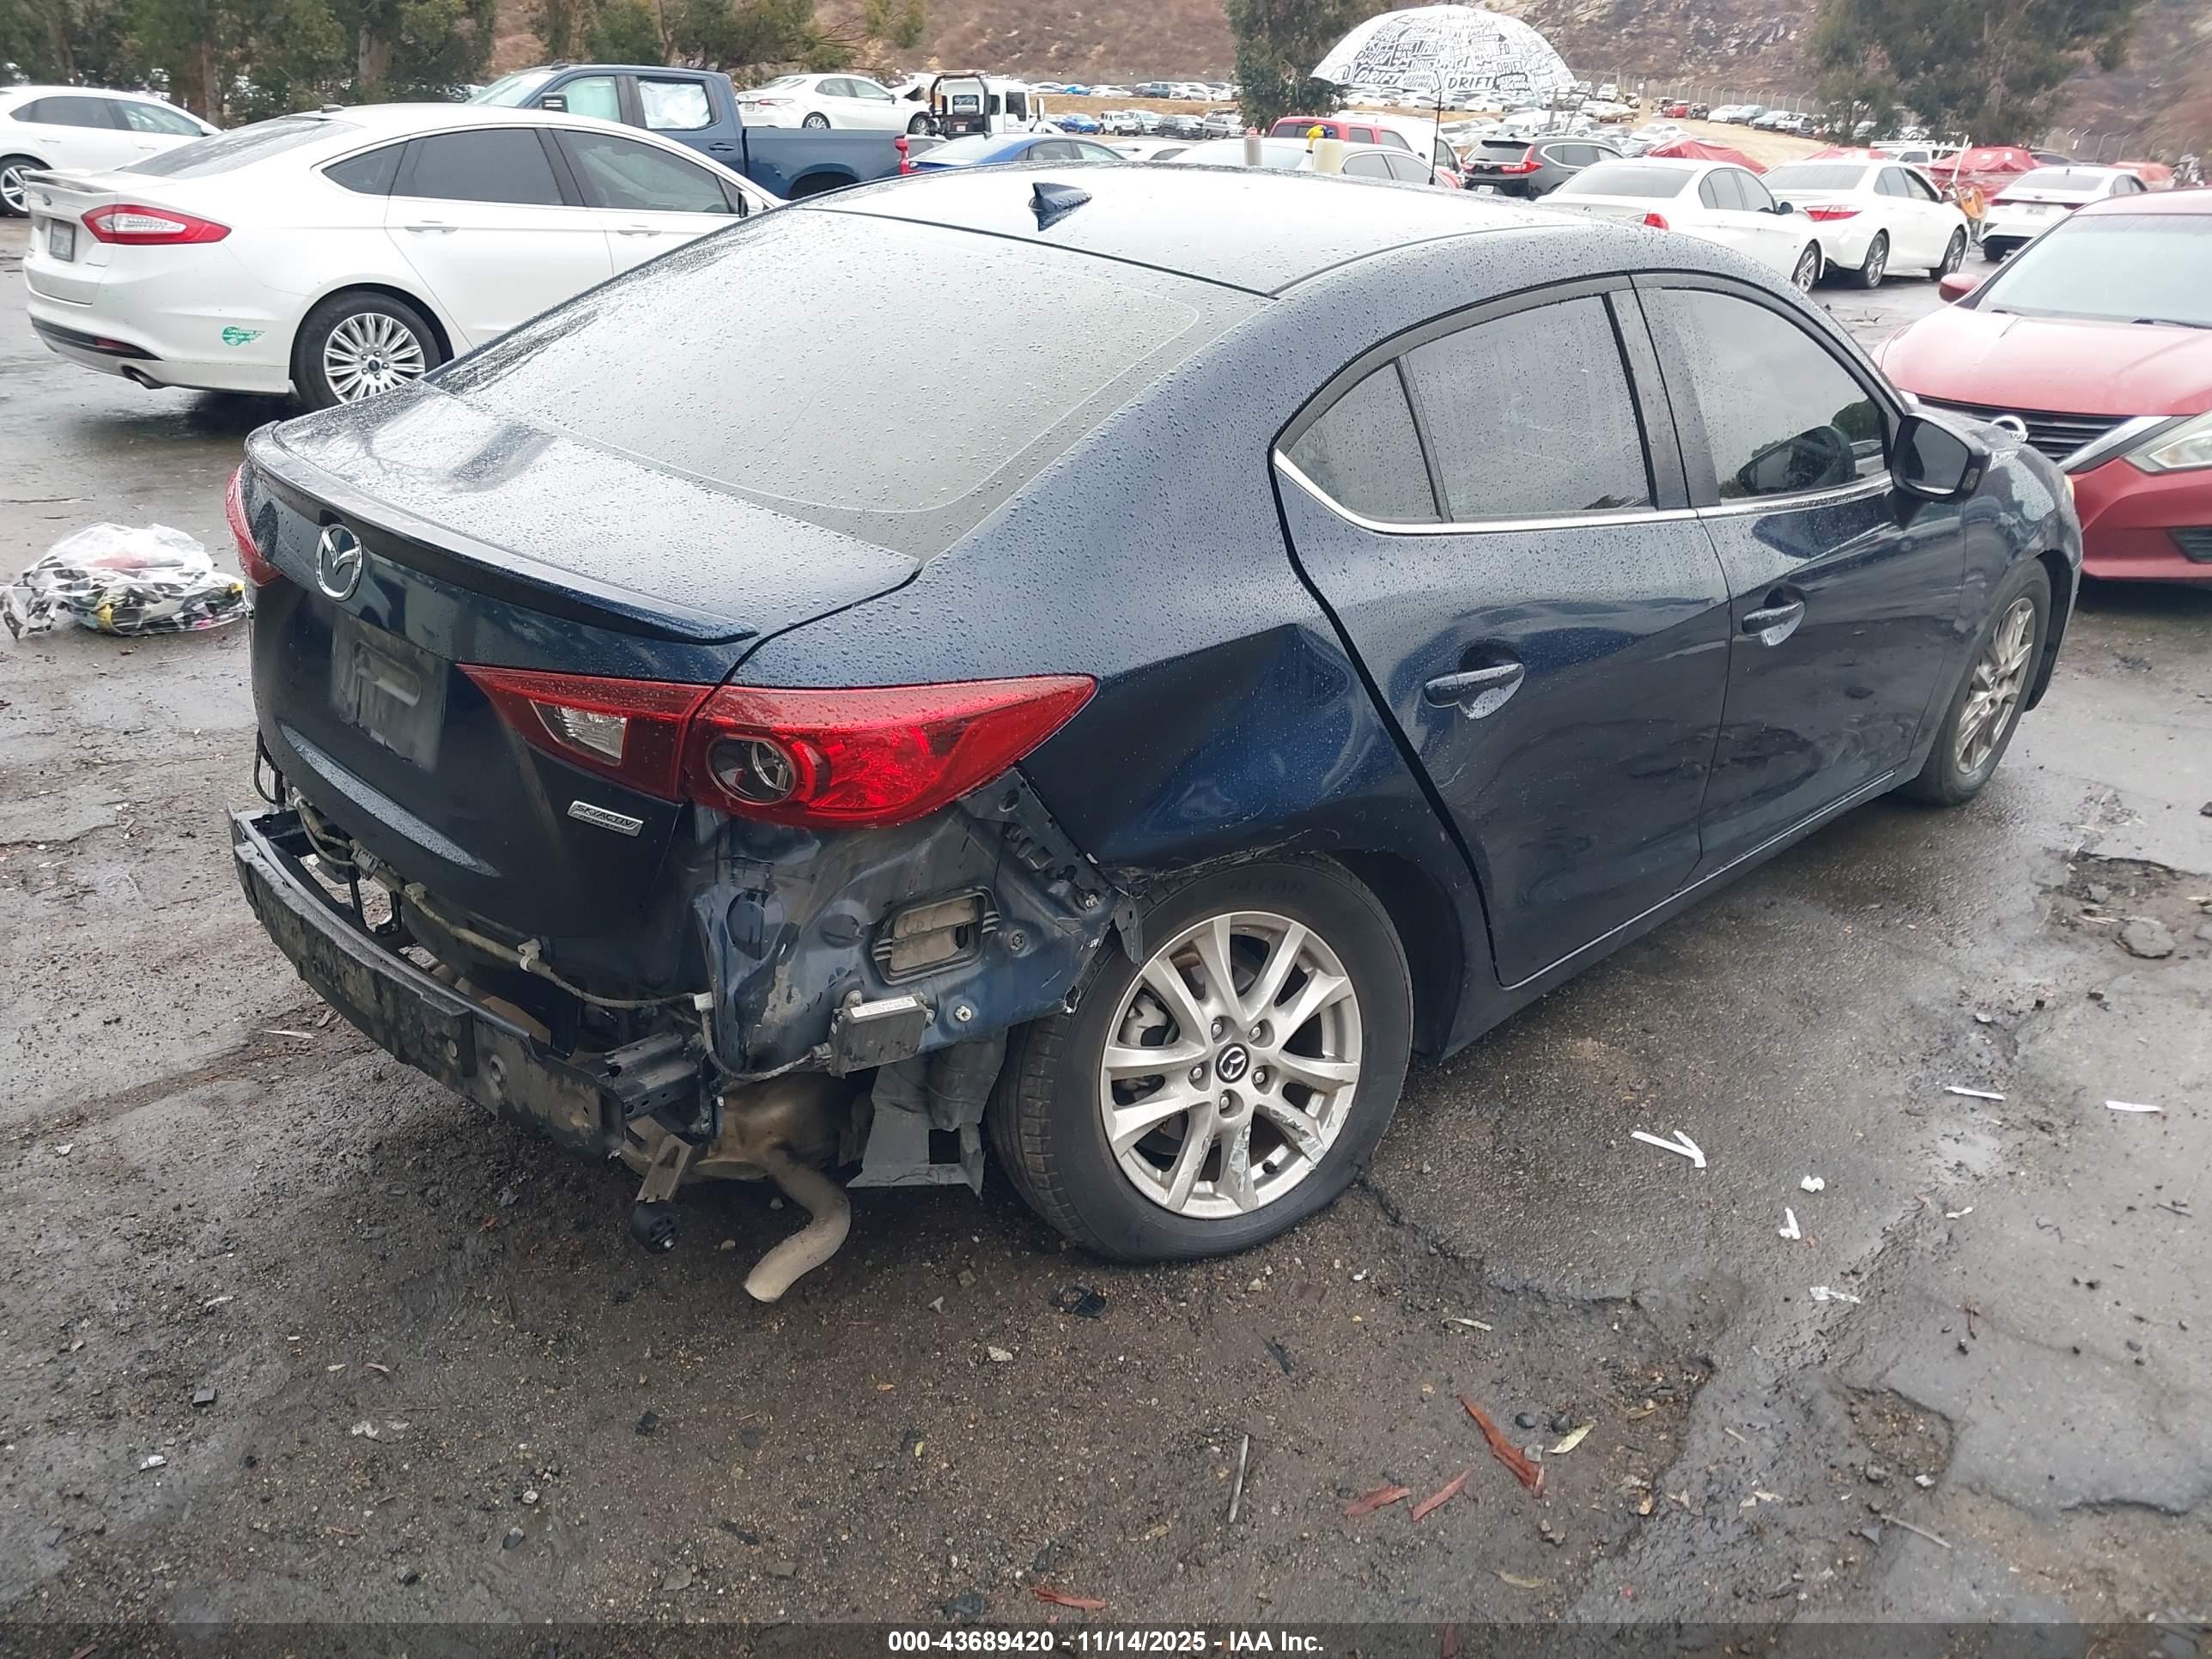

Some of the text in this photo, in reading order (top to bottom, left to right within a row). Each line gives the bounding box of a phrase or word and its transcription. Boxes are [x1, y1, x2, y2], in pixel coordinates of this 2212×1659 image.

[1356, 70, 1402, 84] DRIFT
[1448, 76, 1492, 89] DRIFT
[576, 805, 635, 826] SKYACTIV
